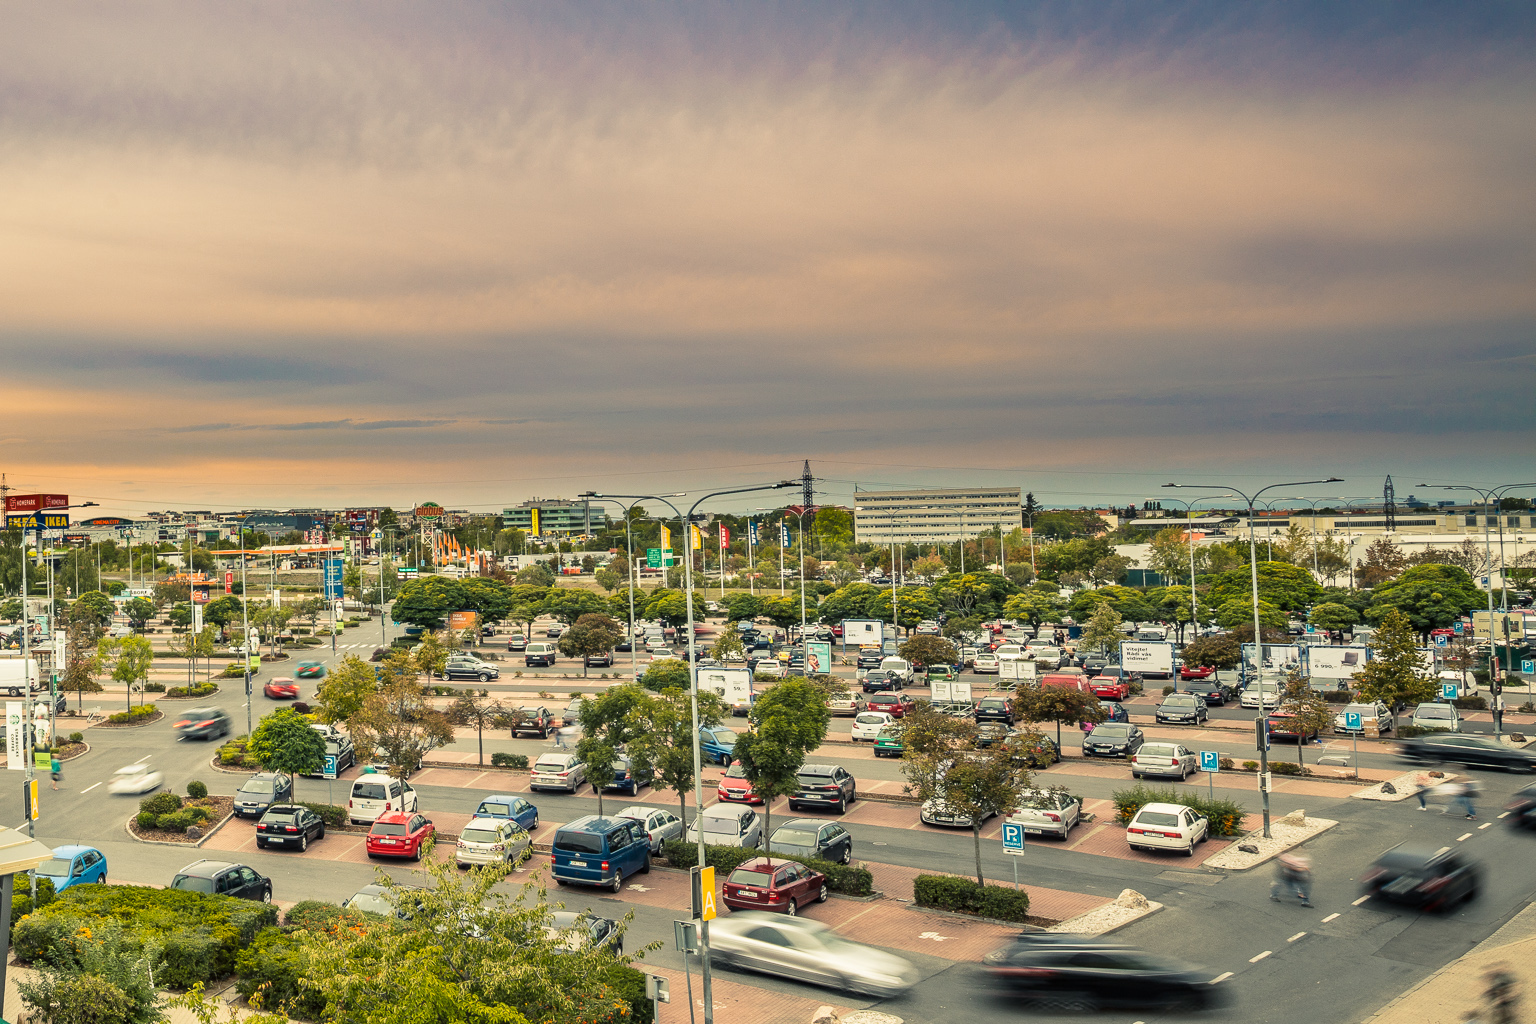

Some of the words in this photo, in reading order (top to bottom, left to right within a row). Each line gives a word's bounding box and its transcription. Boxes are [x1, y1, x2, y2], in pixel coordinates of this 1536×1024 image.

[8, 516, 38, 528] IKEA
[45, 516, 68, 527] IKEA
[1348, 713, 1357, 723] P
[1204, 752, 1214, 764] P
[32, 797, 39, 816] A
[1005, 826, 1019, 841] P
[703, 890, 716, 916] A
